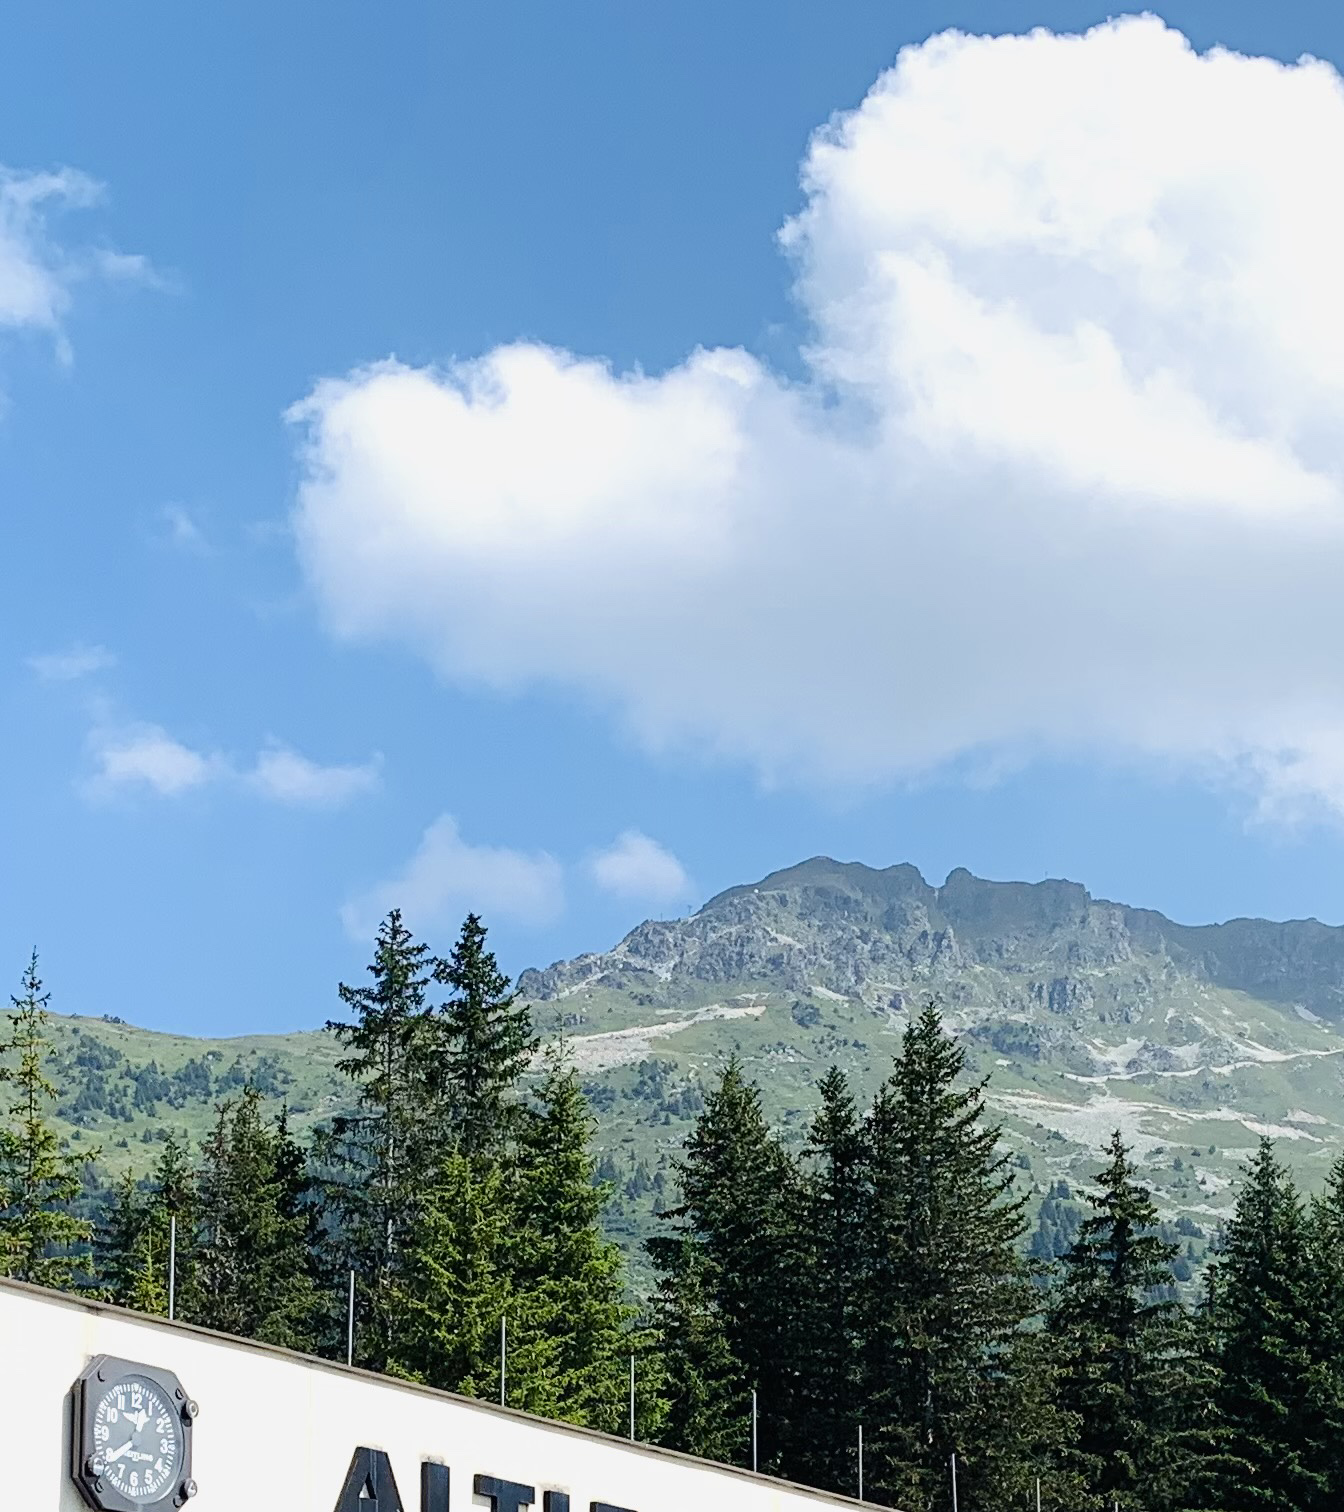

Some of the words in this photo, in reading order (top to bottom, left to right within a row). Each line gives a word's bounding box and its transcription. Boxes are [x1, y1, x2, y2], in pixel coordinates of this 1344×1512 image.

[118, 1394, 125, 1410] 11
[131, 1392, 142, 1409] 12
[149, 1401, 153, 1416] 1
[106, 1407, 118, 1423] 10
[101, 1425, 109, 1441] 9
[156, 1418, 164, 1433] 2
[160, 1438, 168, 1454] 3
[105, 1447, 114, 1463] 8
[118, 1464, 125, 1478] 7
[154, 1458, 163, 1473] 4
[130, 1471, 138, 1487] 6
[145, 1469, 153, 1485] 5
